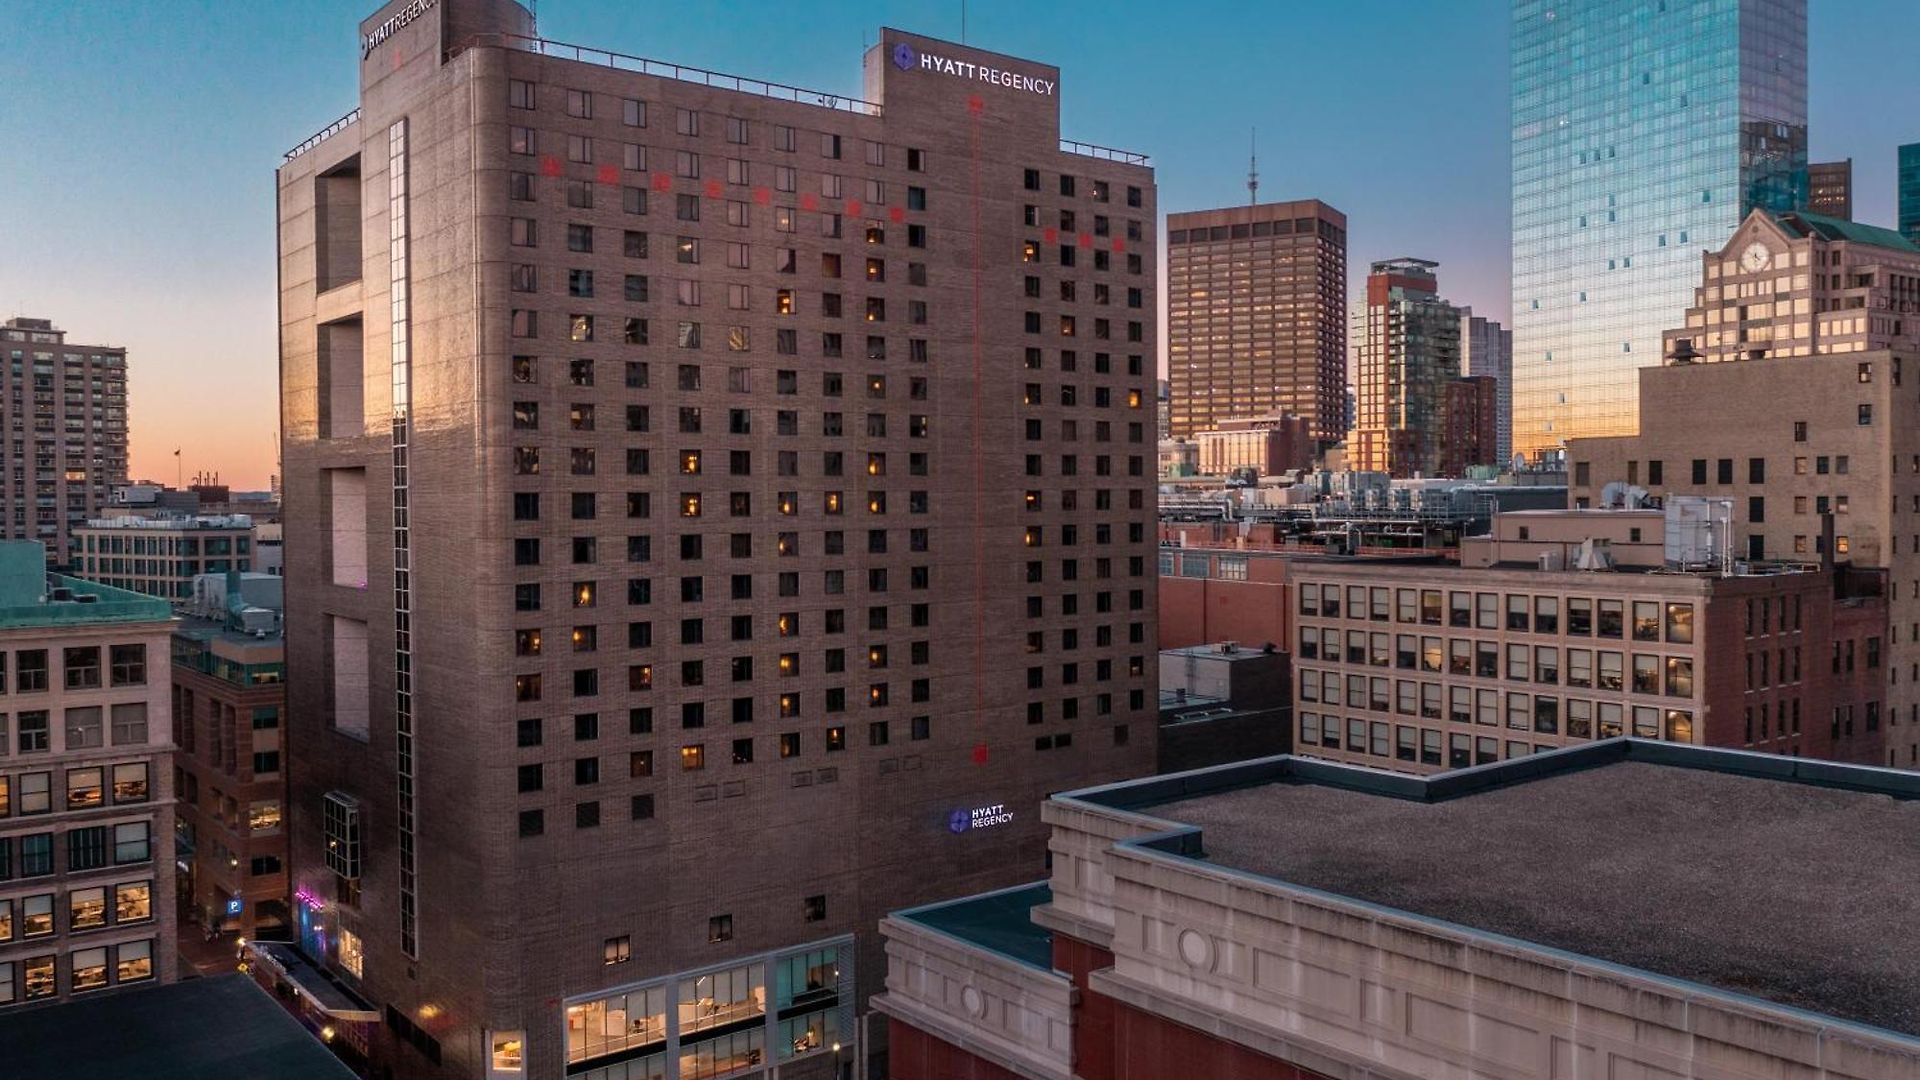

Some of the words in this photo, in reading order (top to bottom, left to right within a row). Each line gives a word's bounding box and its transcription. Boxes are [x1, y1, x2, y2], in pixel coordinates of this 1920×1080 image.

[368, 18, 395, 49] HYATT
[394, 0, 436, 30] REGENC
[920, 53, 976, 79] HYATT
[979, 66, 1055, 95] REGENCY
[971, 804, 1004, 819] HYATT
[971, 812, 1014, 829] REGENCY
